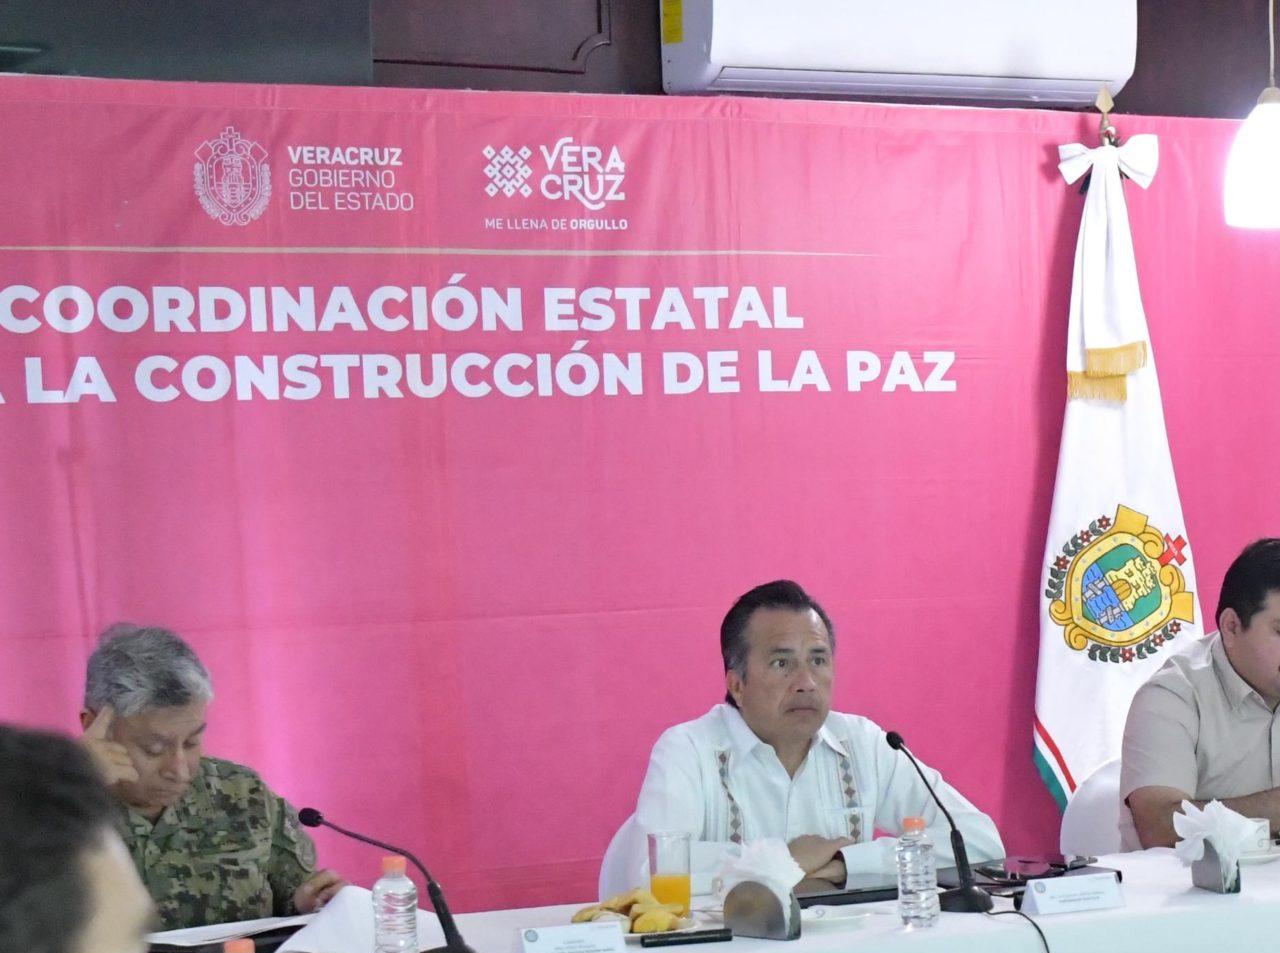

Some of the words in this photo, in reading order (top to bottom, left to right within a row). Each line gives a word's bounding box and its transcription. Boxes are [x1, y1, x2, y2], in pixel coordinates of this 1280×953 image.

[287, 146, 403, 166] VERACRUZ
[539, 136, 626, 173] VERA
[288, 168, 395, 188] GOBIERNO
[540, 174, 626, 211] CRUZ
[290, 191, 330, 211] DEL
[335, 192, 414, 212] ESTADO
[485, 218, 503, 230] ME
[507, 218, 548, 230] LLENA
[551, 218, 567, 230] DE
[570, 218, 628, 231] ORGULLO
[0, 273, 523, 333] COORDINACIÓN
[544, 286, 804, 332] ESTATAL
[25, 356, 117, 404] LA
[134, 340, 643, 402] CONSTRUCCIÓN
[663, 350, 741, 395] DE
[757, 350, 832, 393] LA
[846, 350, 957, 393] PAZ
